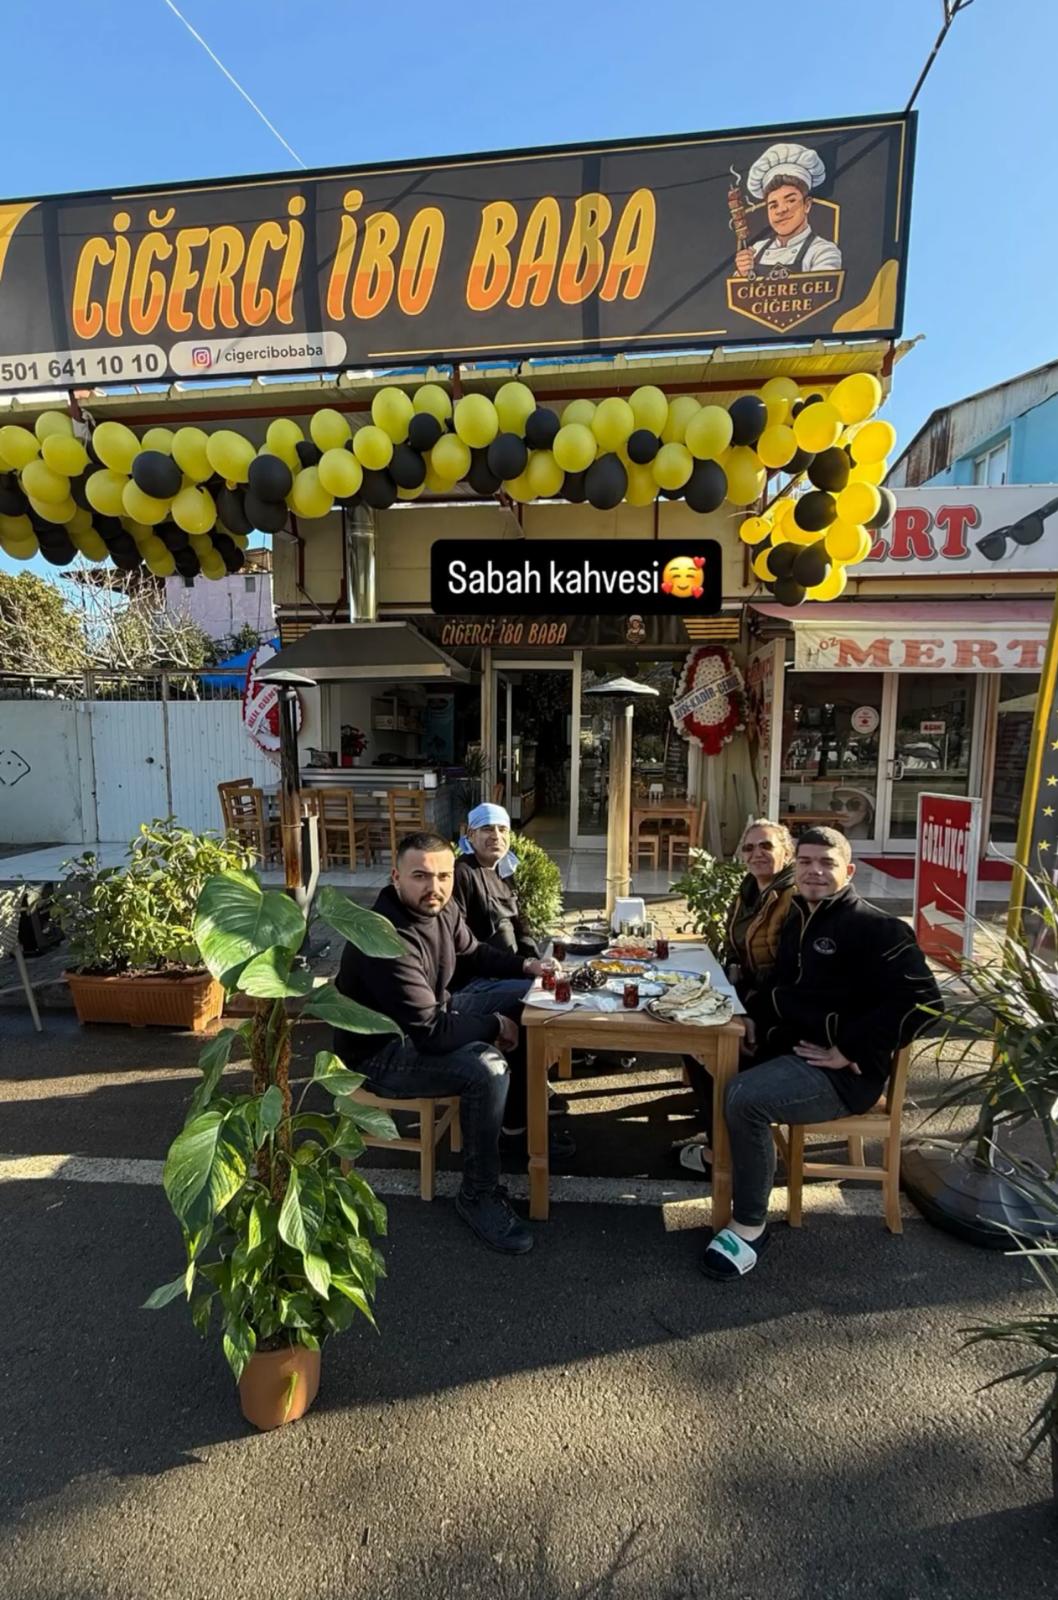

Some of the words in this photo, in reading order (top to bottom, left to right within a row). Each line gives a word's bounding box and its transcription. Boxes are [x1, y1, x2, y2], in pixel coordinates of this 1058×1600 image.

[72, 196, 306, 340] CİĞERCİ
[327, 189, 445, 320] İBO
[467, 188, 656, 311] BABA
[737, 282, 798, 299] CİĞERE
[802, 280, 833, 295] GEL
[751, 299, 812, 314] CİĞERE
[1, 361, 39, 382] 501
[48, 357, 87, 379] 641
[96, 355, 124, 375] 10
[132, 353, 159, 373] 10
[868, 504, 977, 561] RT
[528, 622, 568, 645] BABA
[833, 638, 1048, 668] MERT
